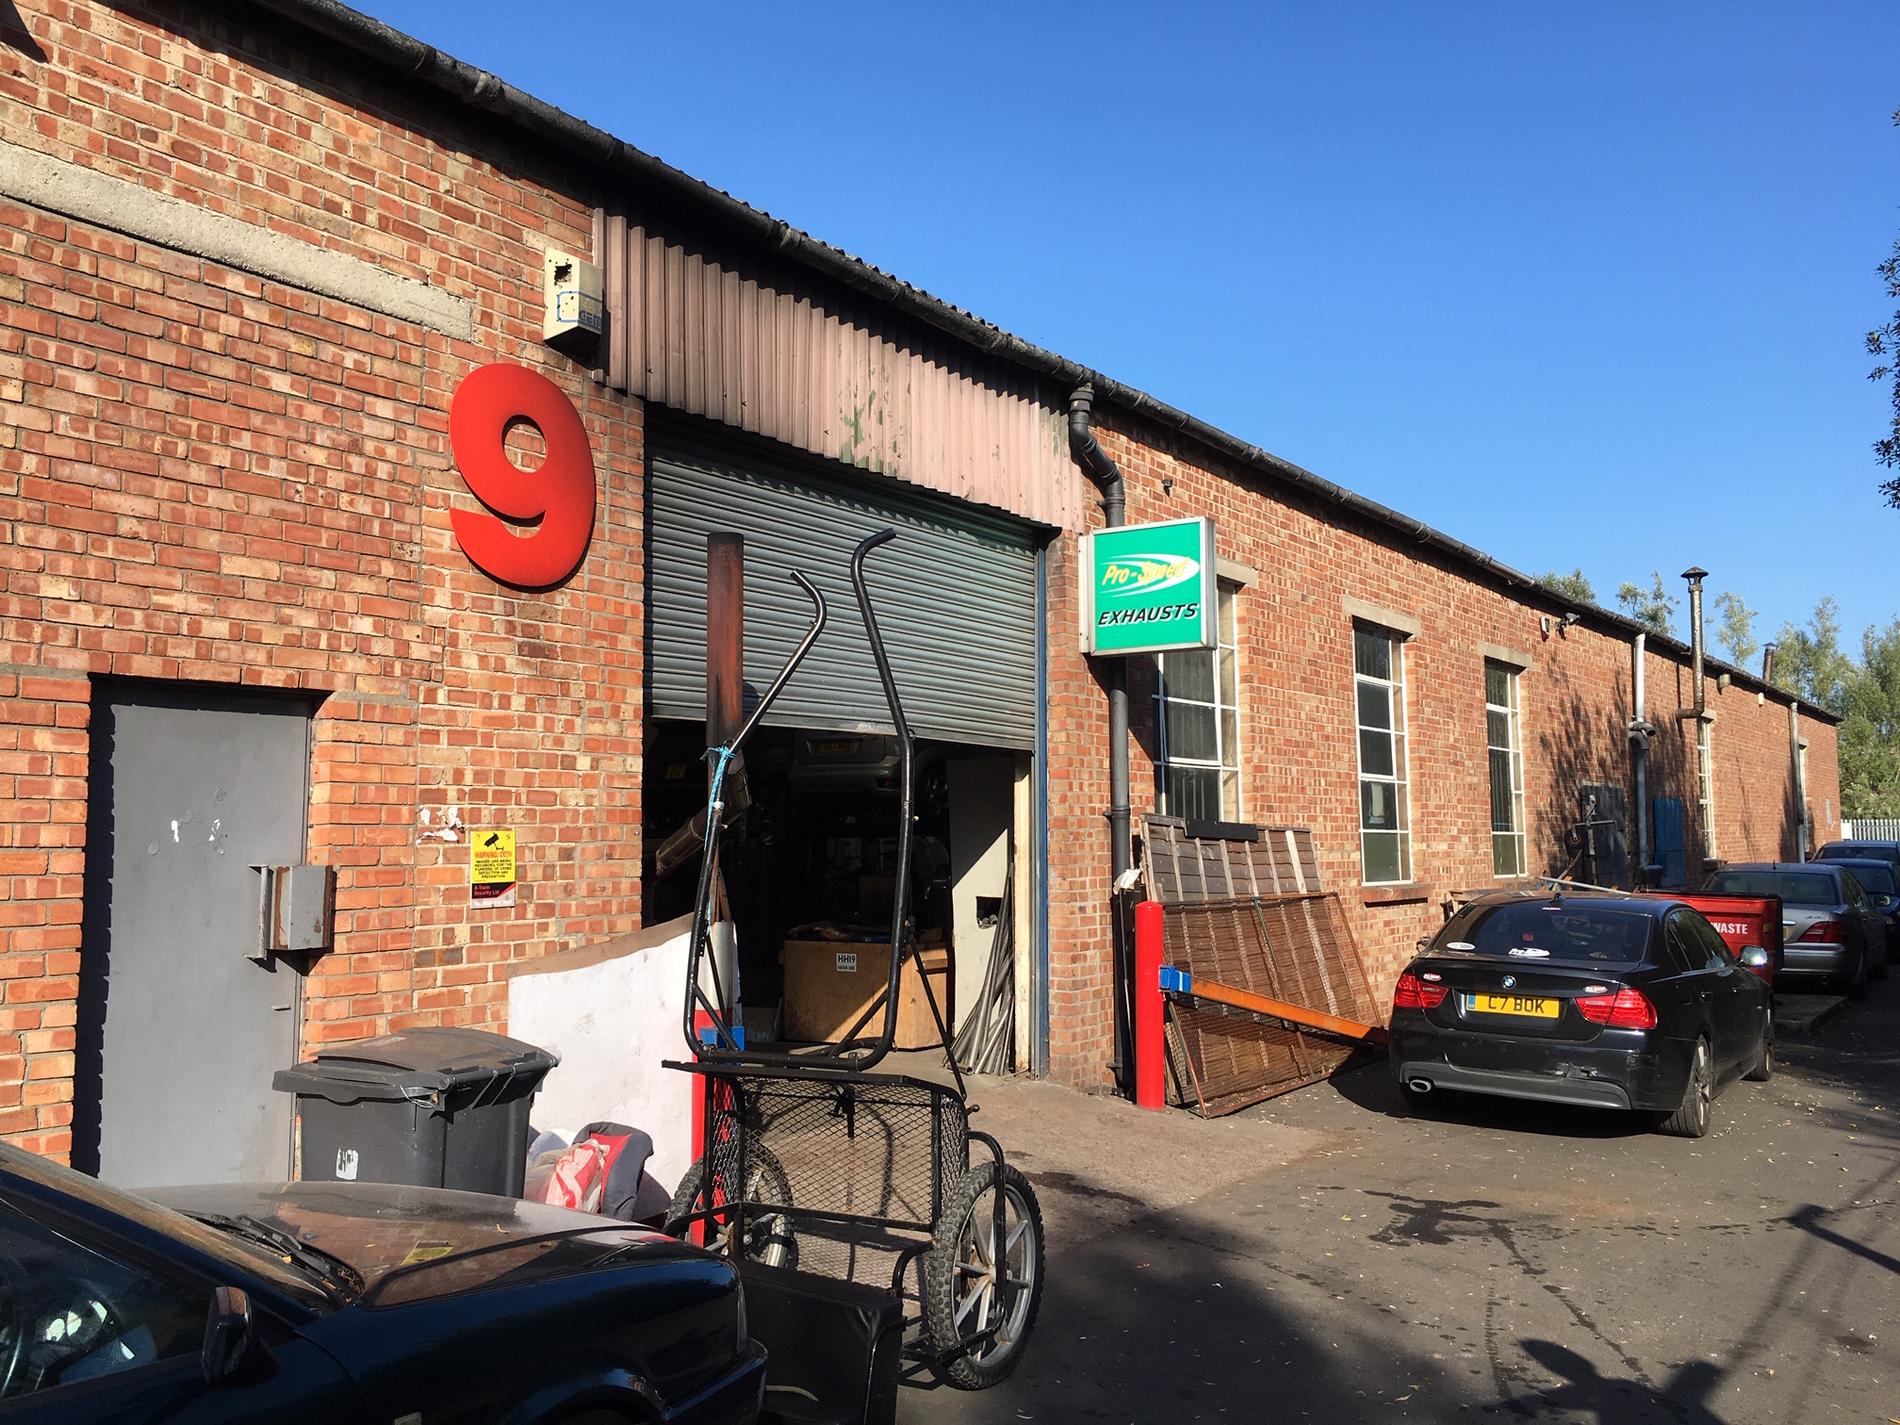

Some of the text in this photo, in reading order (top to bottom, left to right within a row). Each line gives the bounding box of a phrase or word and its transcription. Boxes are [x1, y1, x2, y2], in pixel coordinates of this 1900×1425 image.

[450, 363, 595, 588] 9
[1097, 603, 1199, 627] EXHAUSTS
[1710, 922, 1748, 934] WASTE
[1488, 995, 1508, 1010] C7
